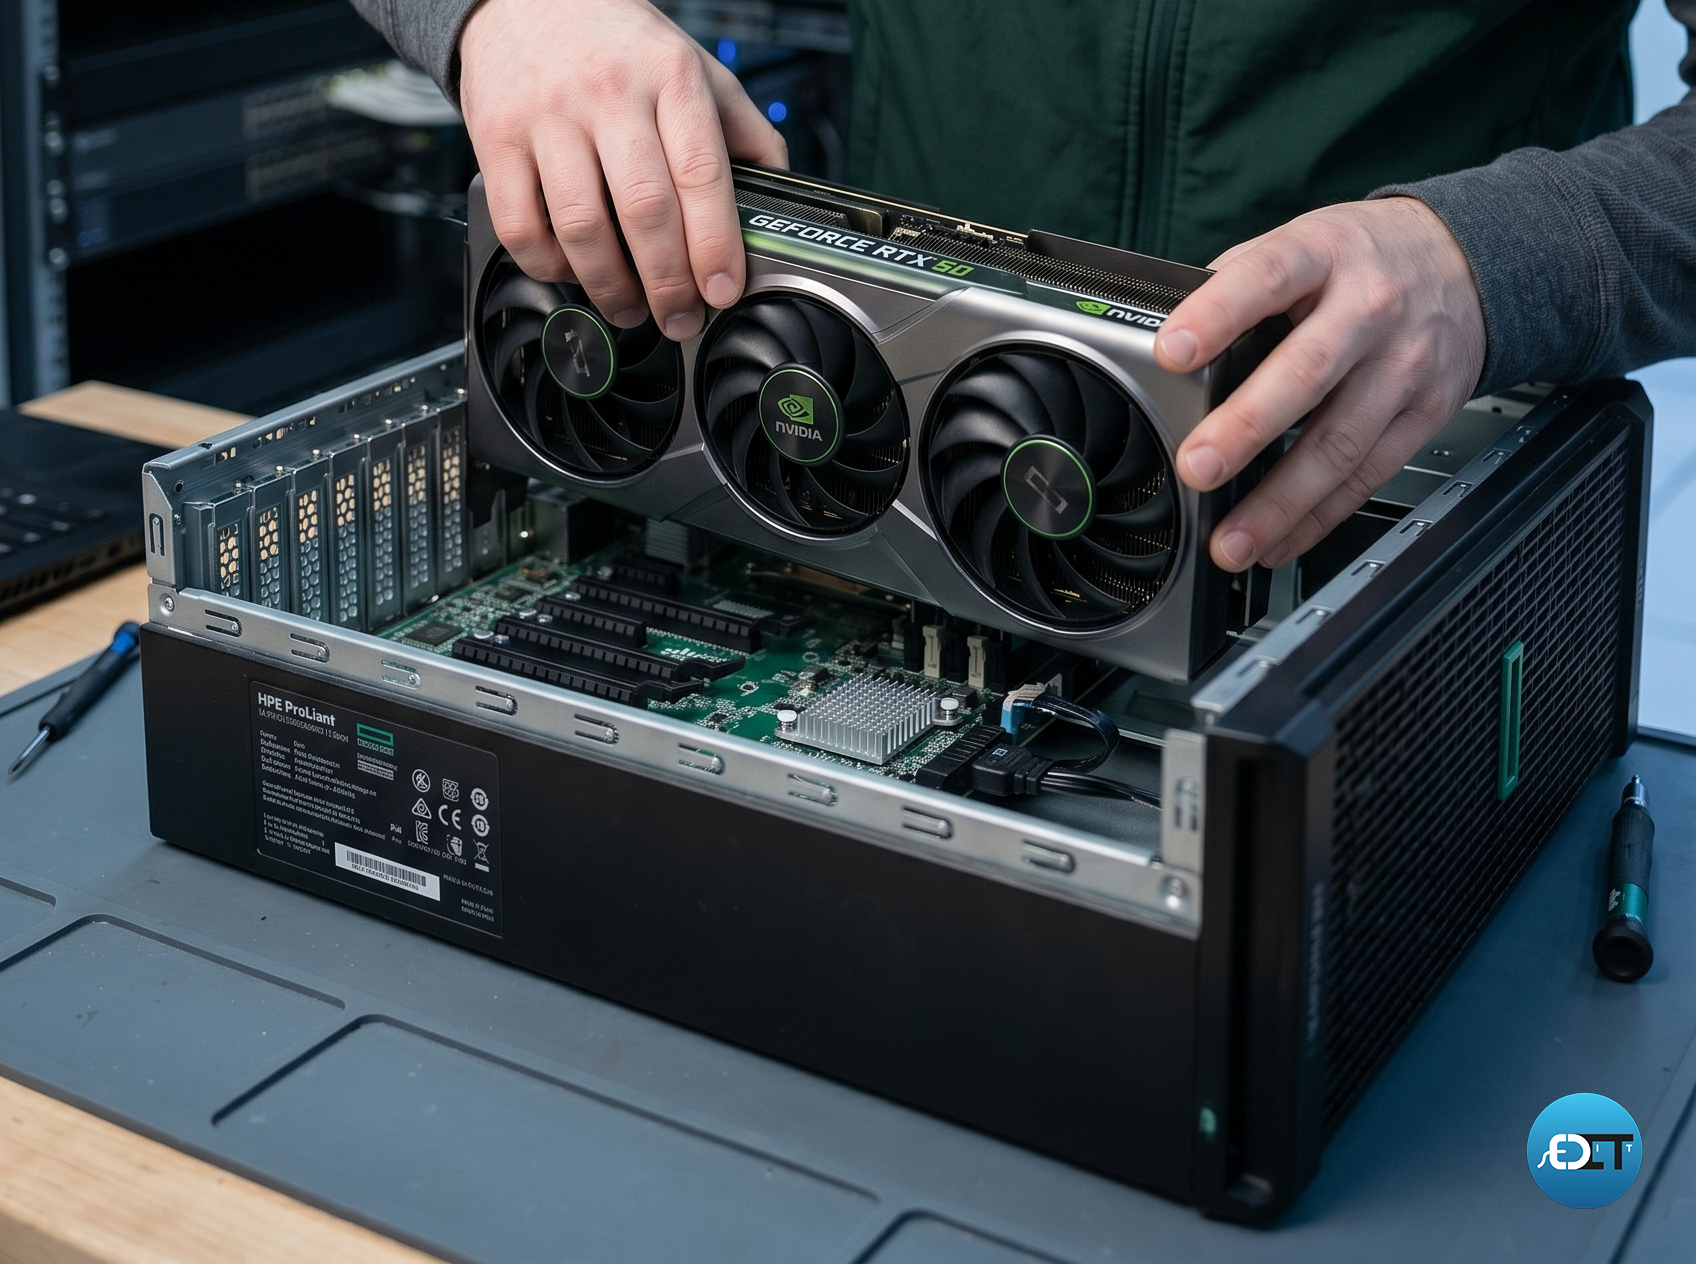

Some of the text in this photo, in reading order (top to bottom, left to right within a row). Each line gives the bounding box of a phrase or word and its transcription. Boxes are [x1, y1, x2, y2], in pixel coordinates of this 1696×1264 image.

[749, 214, 975, 277] GEFORCE RTX 50
[1106, 308, 1165, 328] NVID
[775, 420, 823, 442] NVIDIA
[258, 692, 283, 712] HPE
[285, 700, 336, 727] ProLiant
